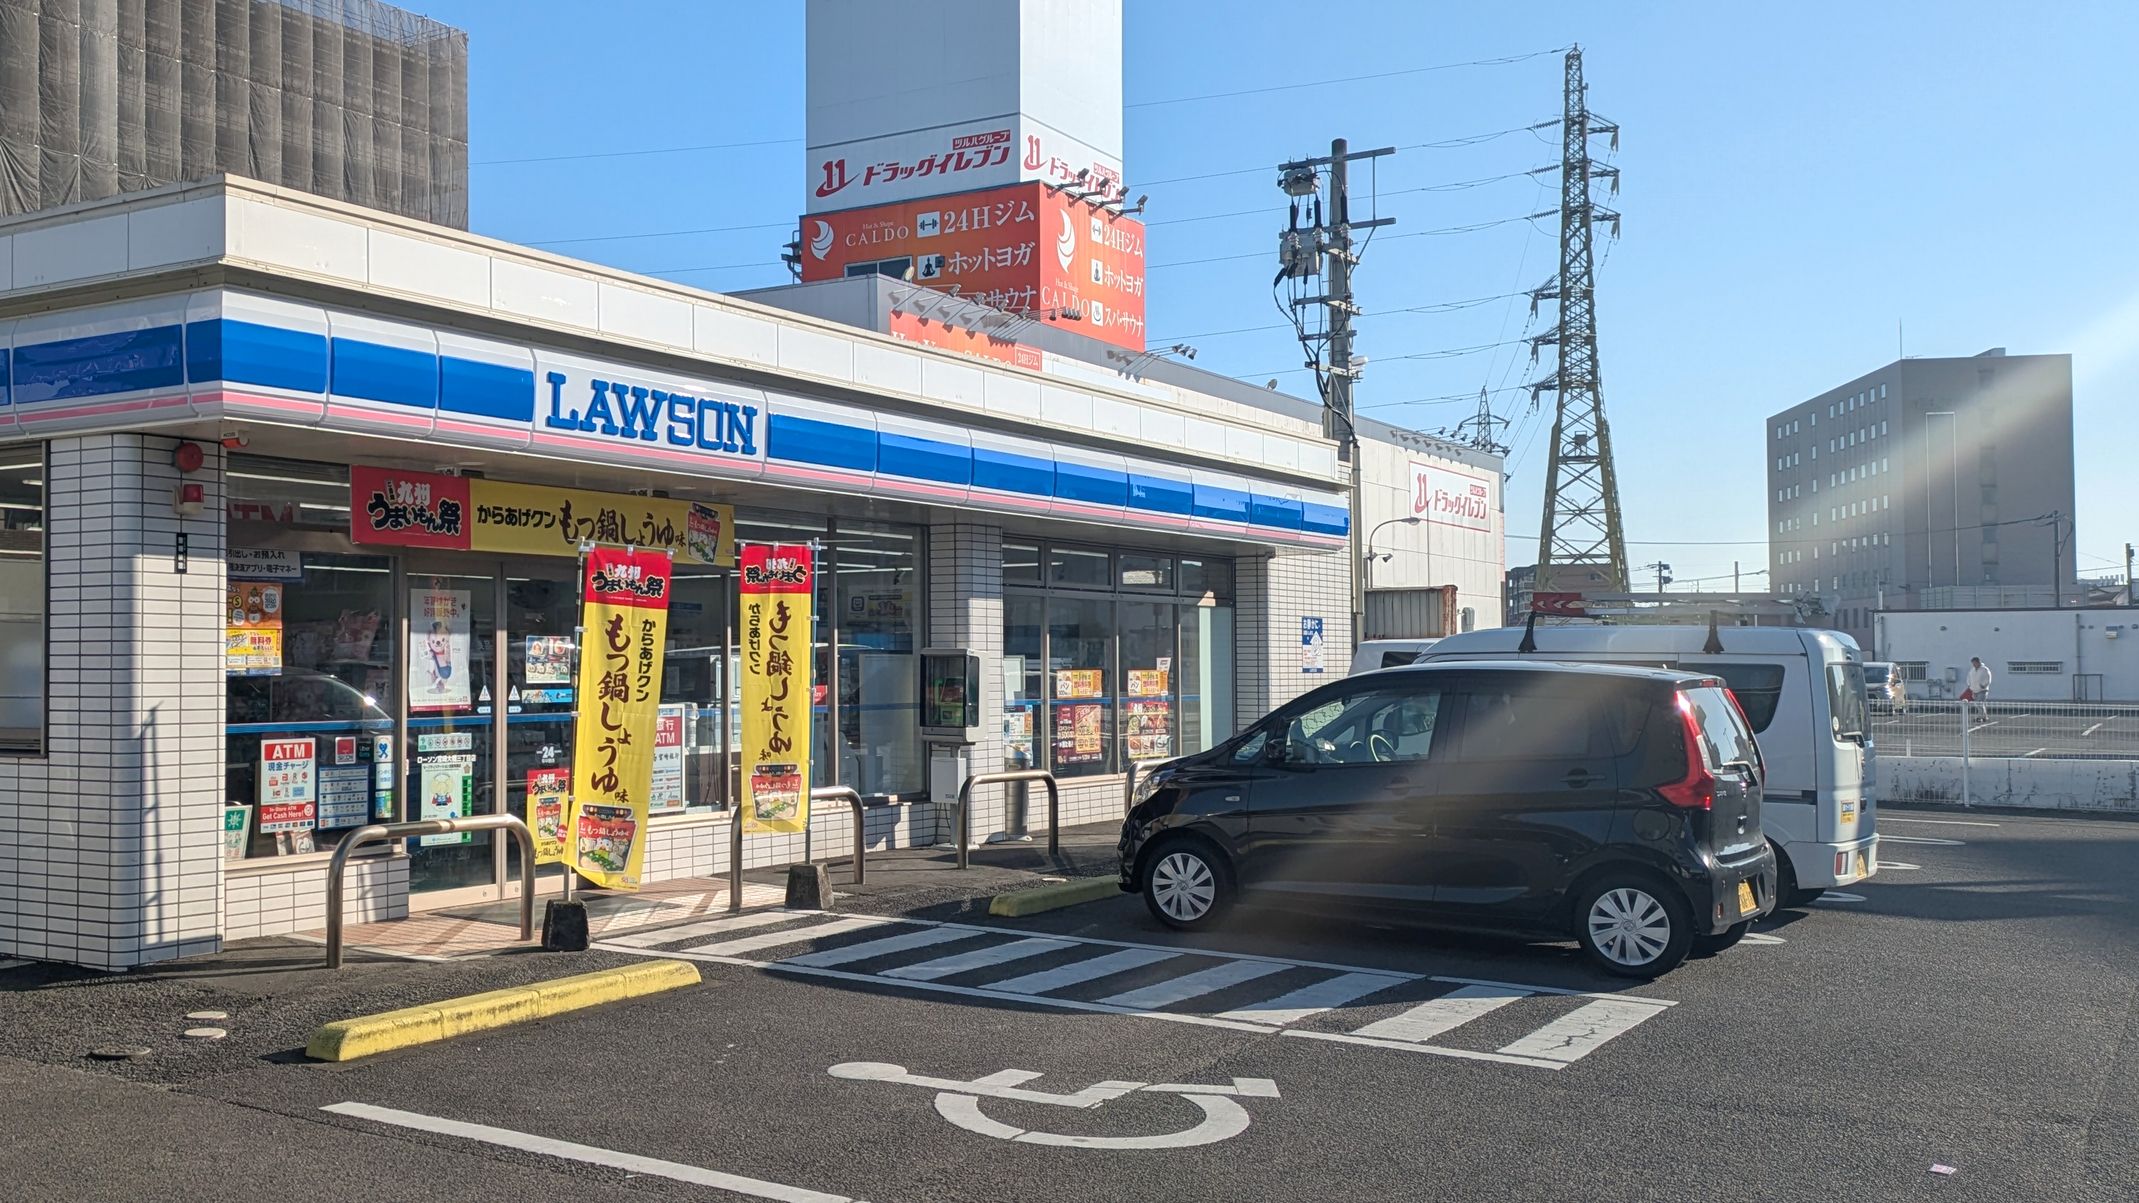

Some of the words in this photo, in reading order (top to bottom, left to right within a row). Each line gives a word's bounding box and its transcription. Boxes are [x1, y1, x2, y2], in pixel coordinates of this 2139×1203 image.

[954, 131, 1010, 148] ツルハグループ
[863, 146, 1011, 186] ドラッグイレブン
[943, 200, 1036, 234] 24Hジム
[845, 225, 909, 247] CALDO
[1104, 224, 1143, 258] 24Hジム
[947, 242, 1036, 275] ホットヨガ
[1104, 265, 1143, 297] ホットヨガ
[1041, 286, 1090, 318] CALDO
[1017, 352, 1040, 367] 24Hジム
[545, 370, 758, 456] LAWSON
[398, 481, 430, 505] 九州
[1434, 488, 1486, 519] ドラッグイレブン
[368, 491, 461, 535] うまいもん祭
[477, 504, 556, 528] からあげクン
[559, 500, 686, 547] もつ鍋しょうゆ味
[591, 571, 665, 598] うまいもん祭
[615, 564, 642, 579] 九州
[636, 618, 656, 702] からあげクン
[591, 613, 633, 803] もつ鍋しょうゆ味
[268, 760, 309, 771] 現金チャージ
[272, 743, 306, 760] ATM
[542, 746, 555, 758] 24
[273, 812, 288, 820] Cash
[289, 810, 304, 818] Here!
